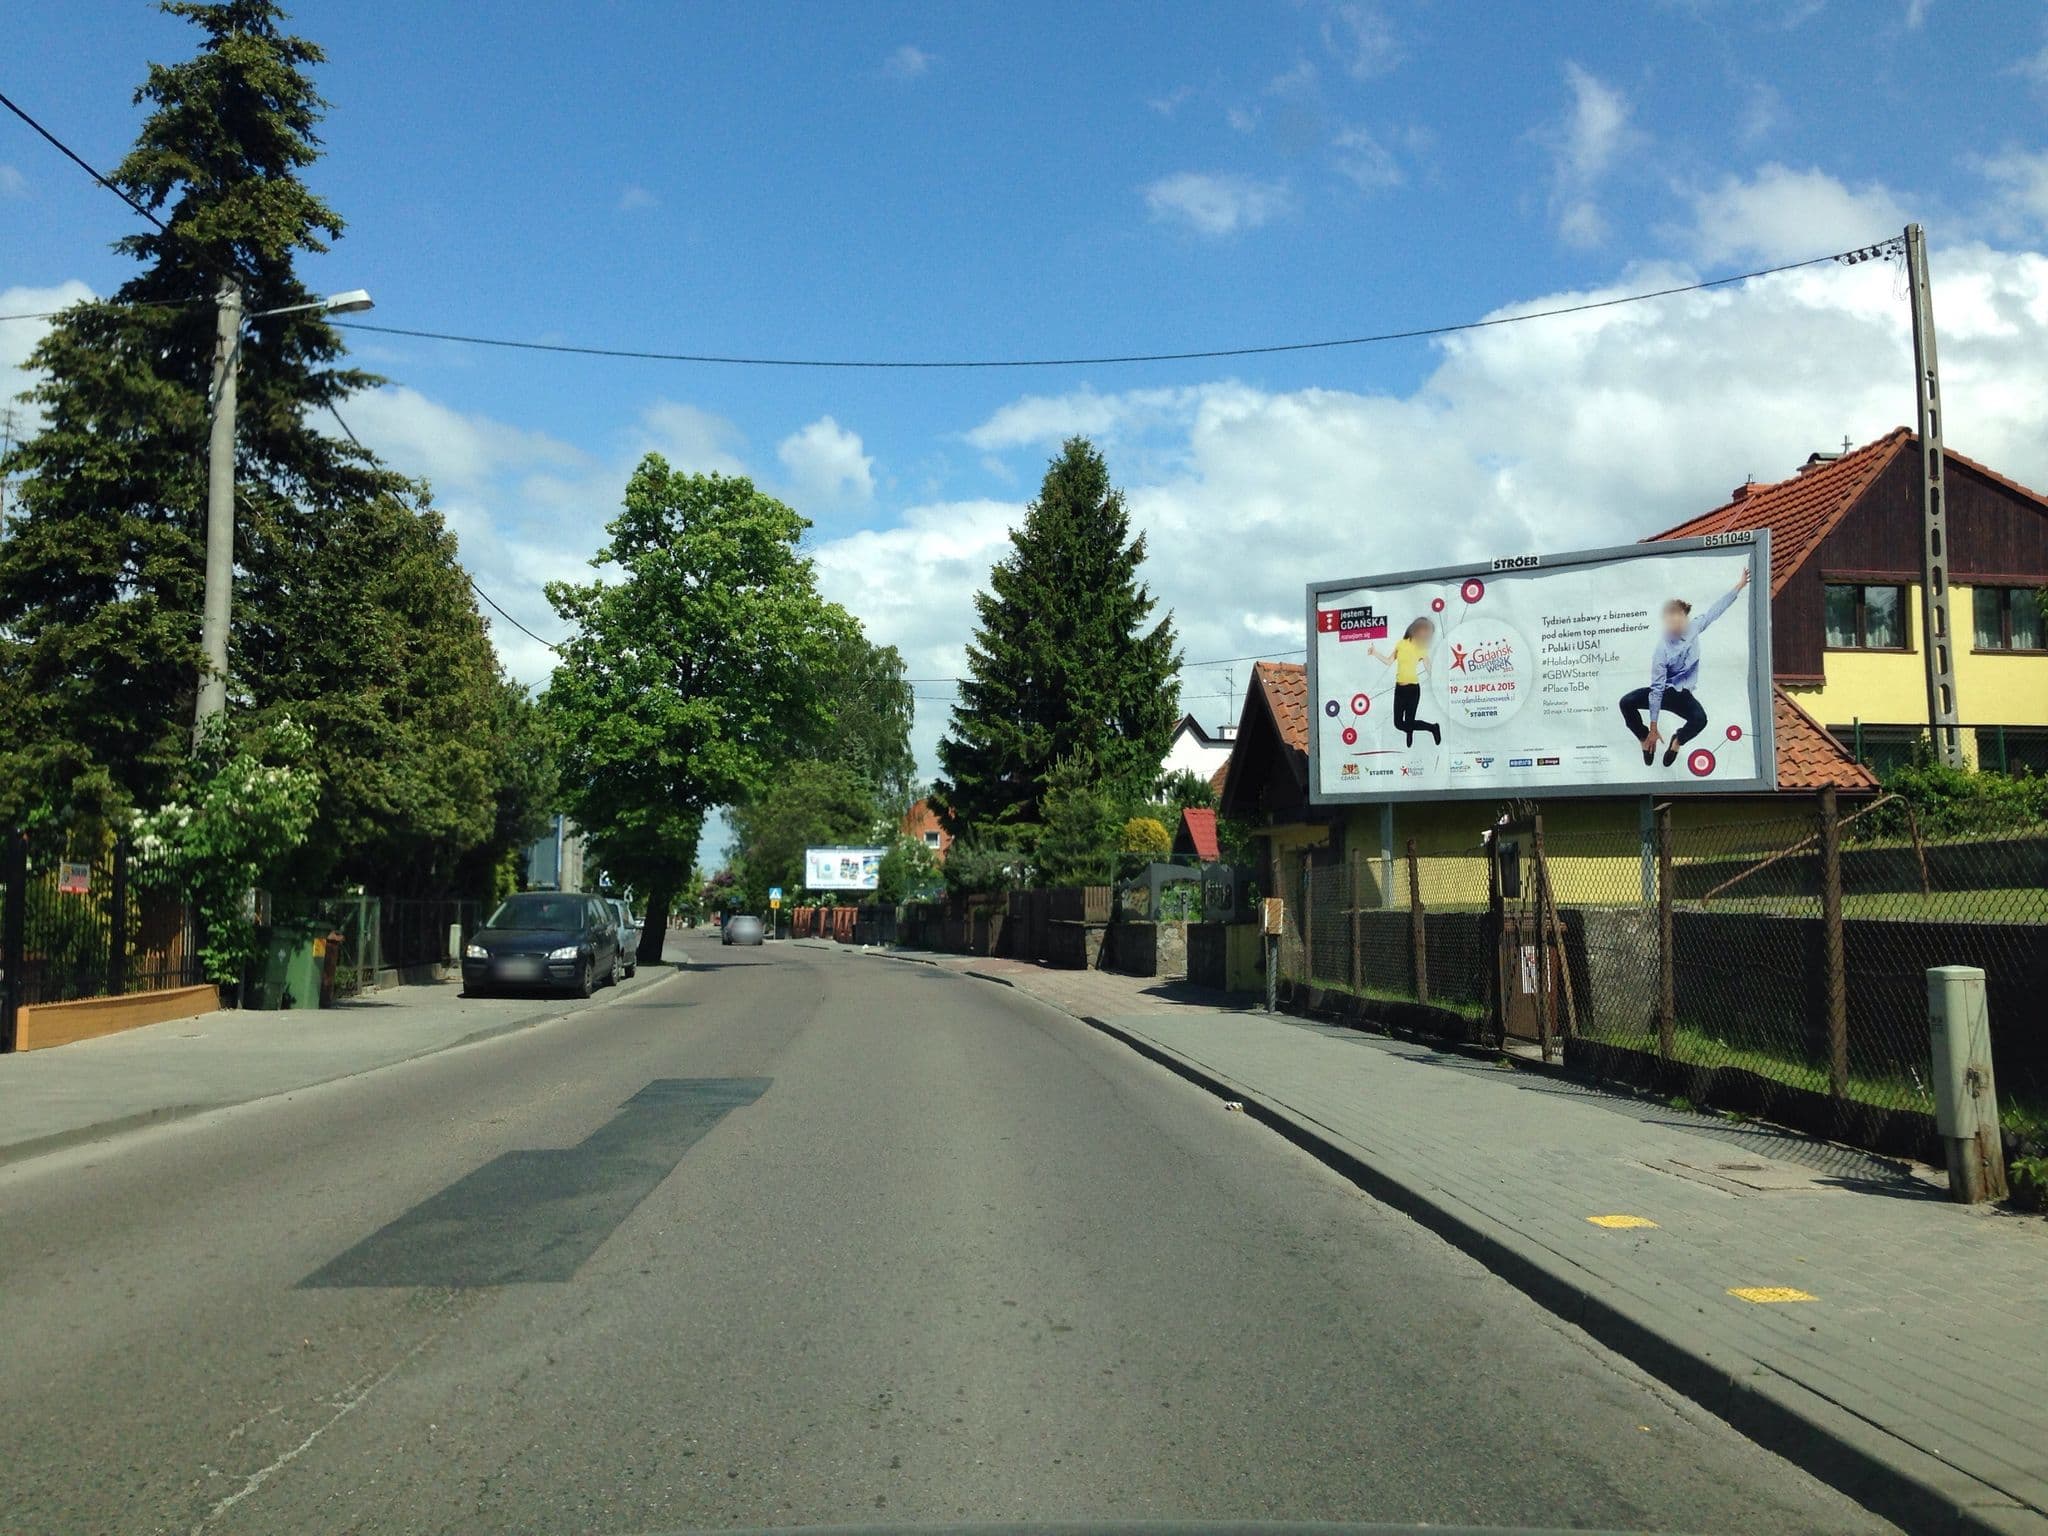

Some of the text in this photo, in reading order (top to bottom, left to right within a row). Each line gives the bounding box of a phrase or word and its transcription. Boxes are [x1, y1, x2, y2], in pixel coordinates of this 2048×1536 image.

[1704, 531, 1751, 546] 8511049
[1493, 556, 1538, 569] STRÖER
[1340, 609, 1364, 620] jestem
[1541, 615, 1572, 628] Tydzień
[1572, 612, 1601, 623] zabawy
[1609, 610, 1648, 620] biznesem
[1340, 617, 1385, 630] GDAŃSKA
[1541, 623, 1650, 642] pod okiem top menedżerów
[1548, 642, 1571, 653] Polski
[1576, 639, 1600, 651] USA!
[1542, 668, 1600, 680] #GBWStarter
[1450, 686, 1458, 694] 19
[1463, 685, 1473, 693] 24
[1474, 683, 1496, 693] LIPCA
[1497, 682, 1515, 691] 2015
